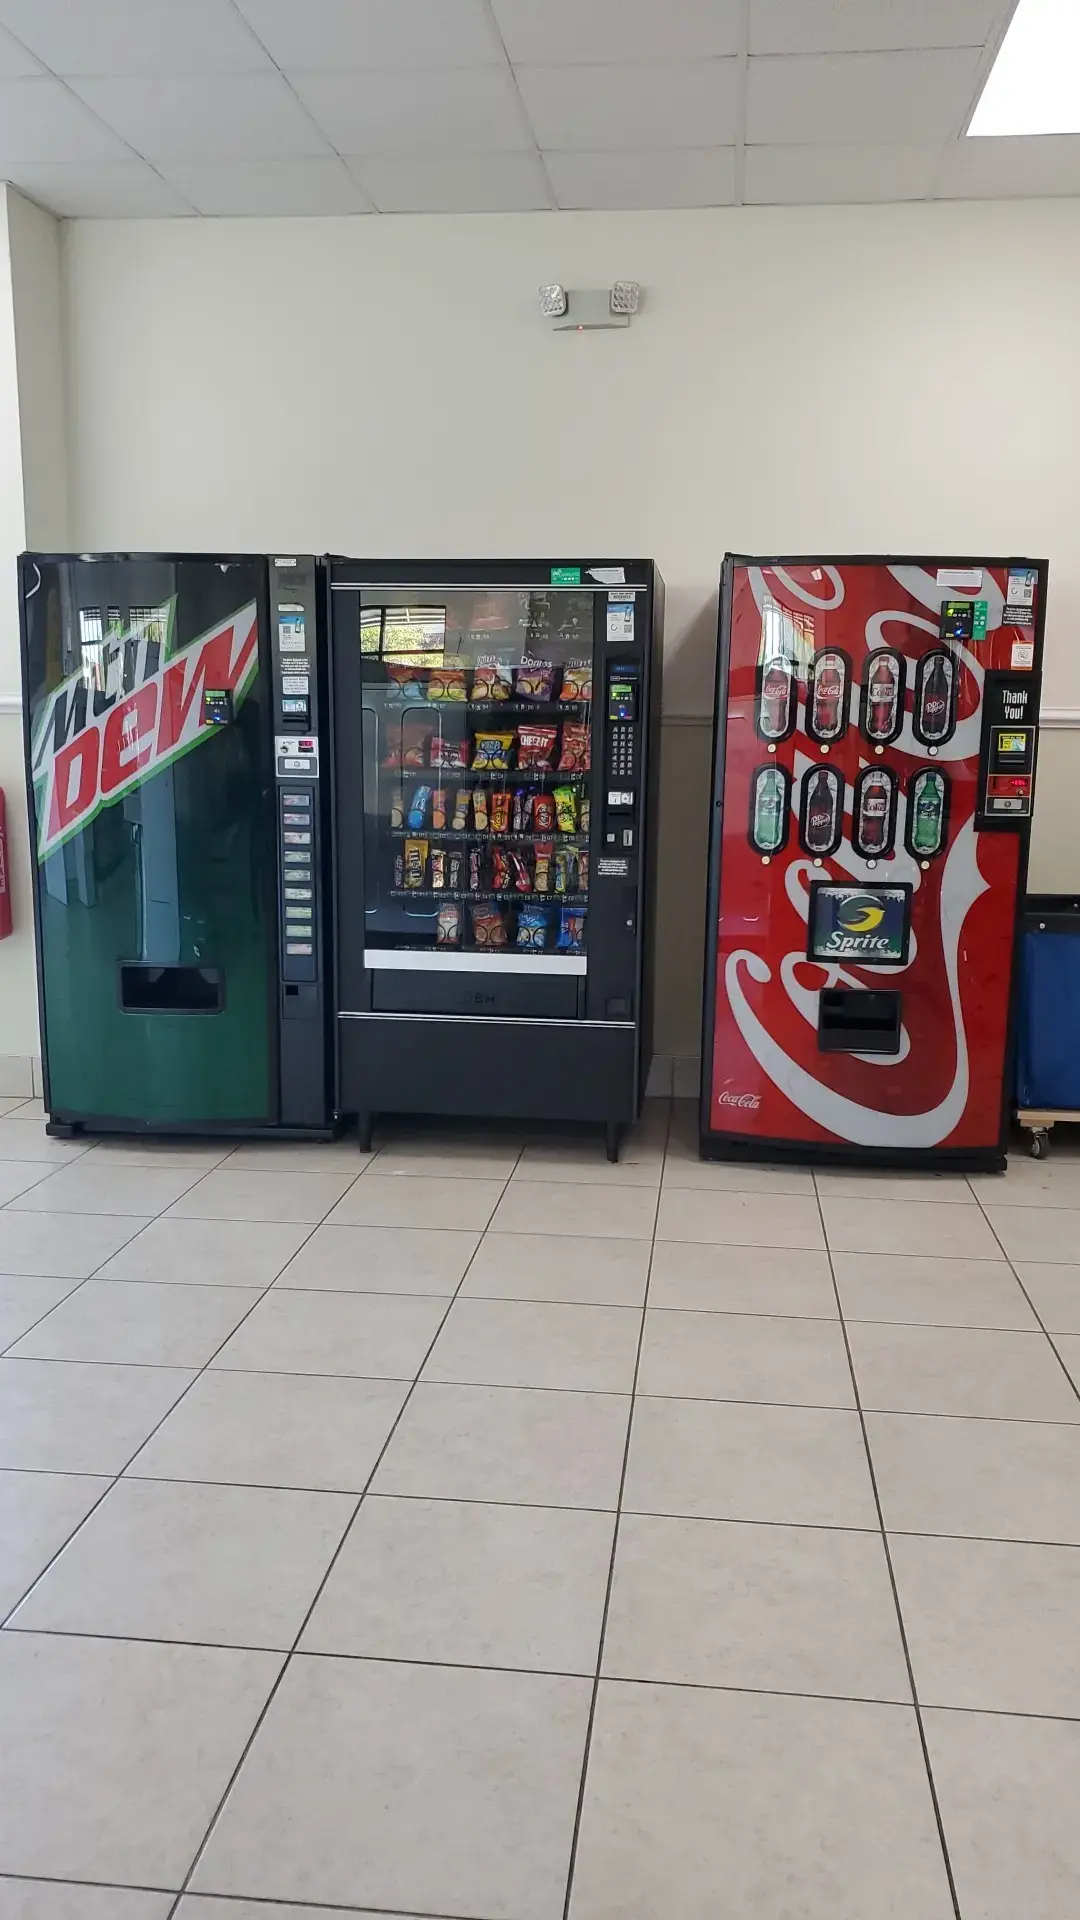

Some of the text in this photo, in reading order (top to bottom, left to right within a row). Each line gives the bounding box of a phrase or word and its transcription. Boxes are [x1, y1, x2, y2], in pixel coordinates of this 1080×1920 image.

[520, 655, 553, 668] Doritos
[1002, 690, 1028, 704] Thank
[1004, 706, 1024, 719] You!
[826, 931, 890, 952] Sprite
